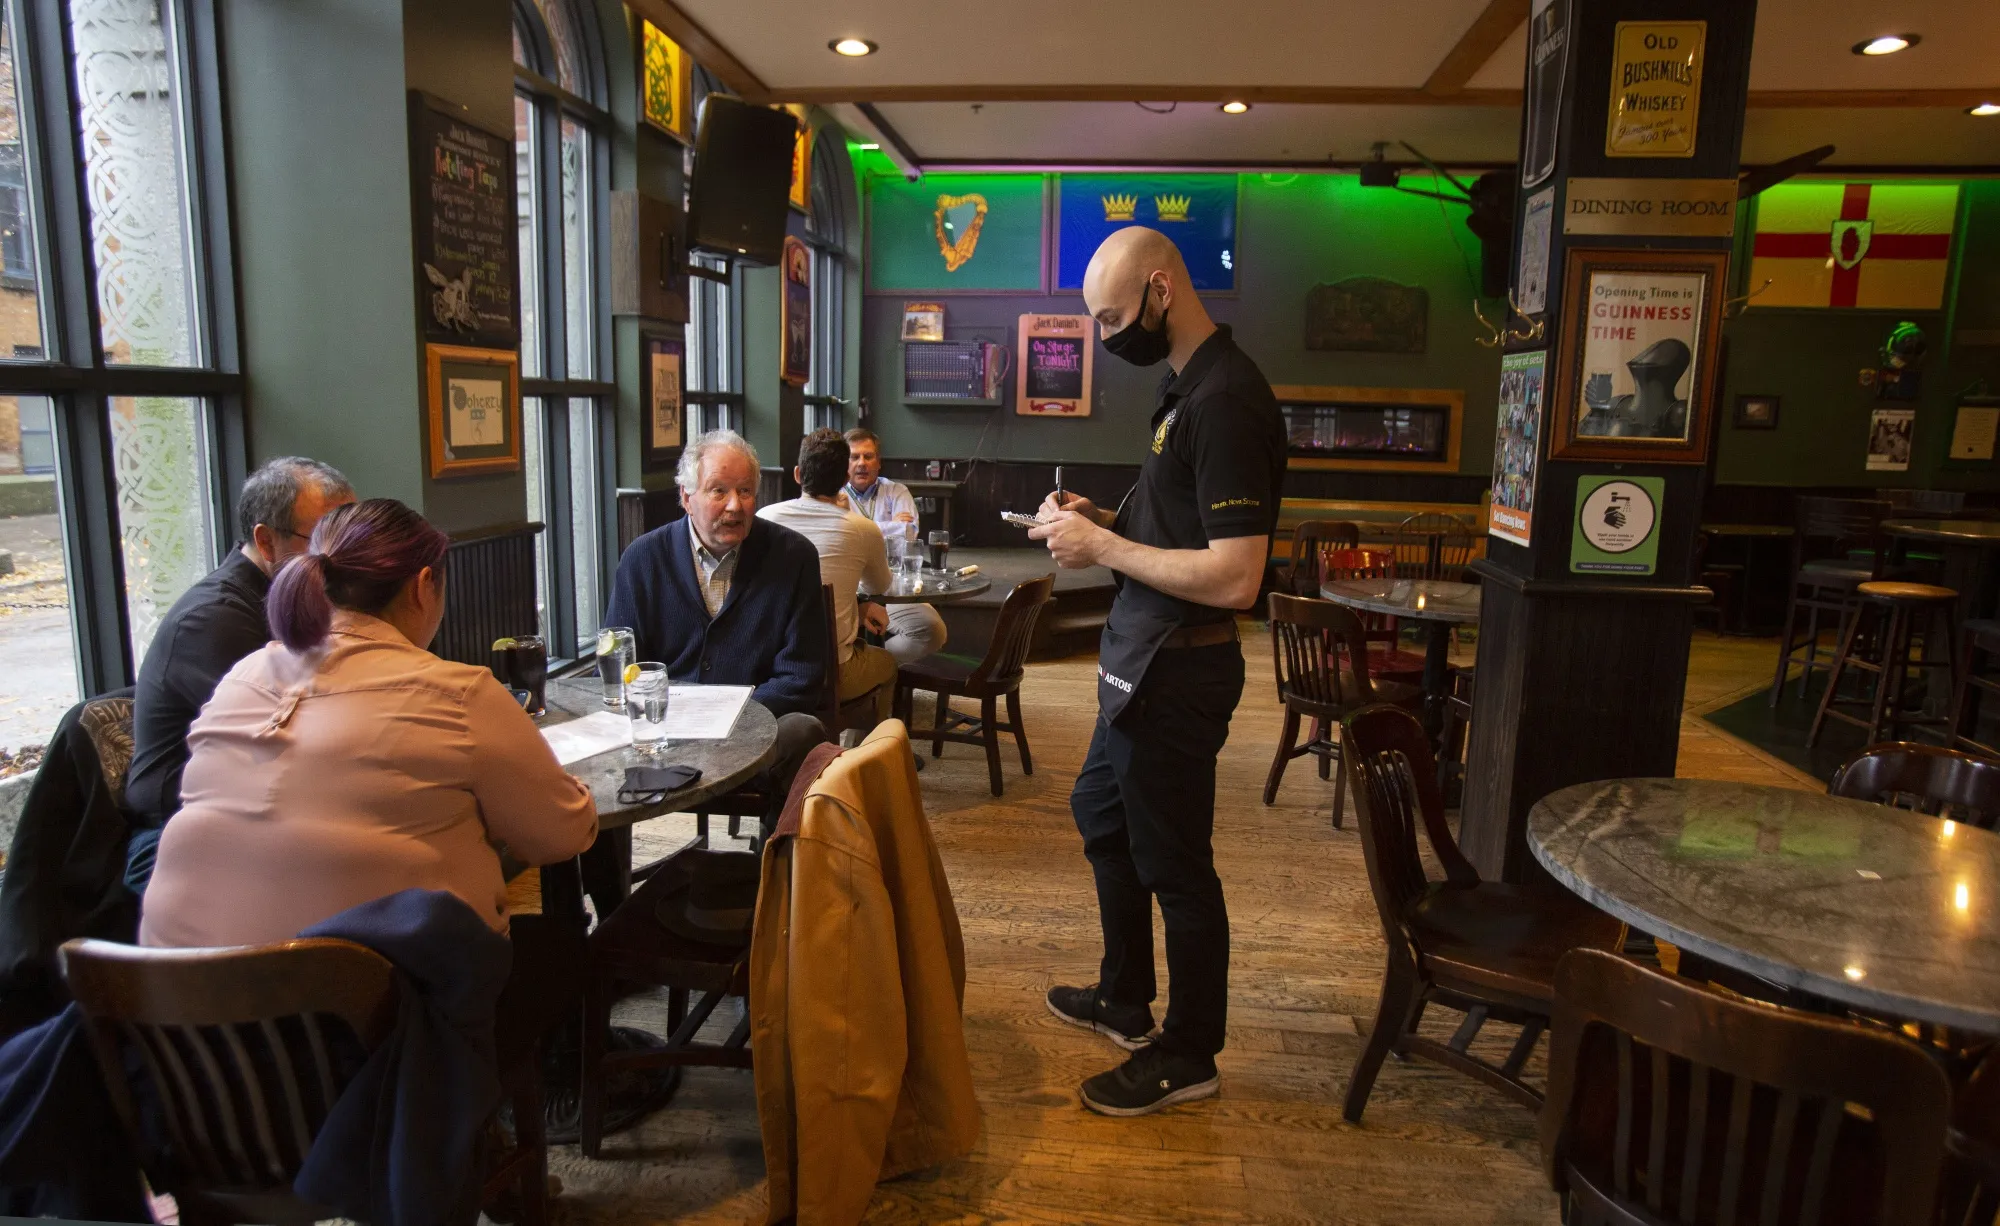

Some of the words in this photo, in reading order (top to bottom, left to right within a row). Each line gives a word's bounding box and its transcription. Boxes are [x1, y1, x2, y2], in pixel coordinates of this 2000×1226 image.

[1644, 33, 1678, 50] OLD
[1623, 60, 1693, 88] BUSHMILLS
[1625, 92, 1687, 111] WHISKEY
[1572, 199, 1652, 214] DINING
[1660, 201, 1729, 215] ROOM
[1594, 285, 1646, 301] Opening
[1650, 287, 1679, 298] Time
[1683, 287, 1693, 298] is
[1593, 302, 1692, 321] GUINNESS
[1592, 326, 1636, 340] TIME
[1104, 672, 1132, 693] ARTOIS
